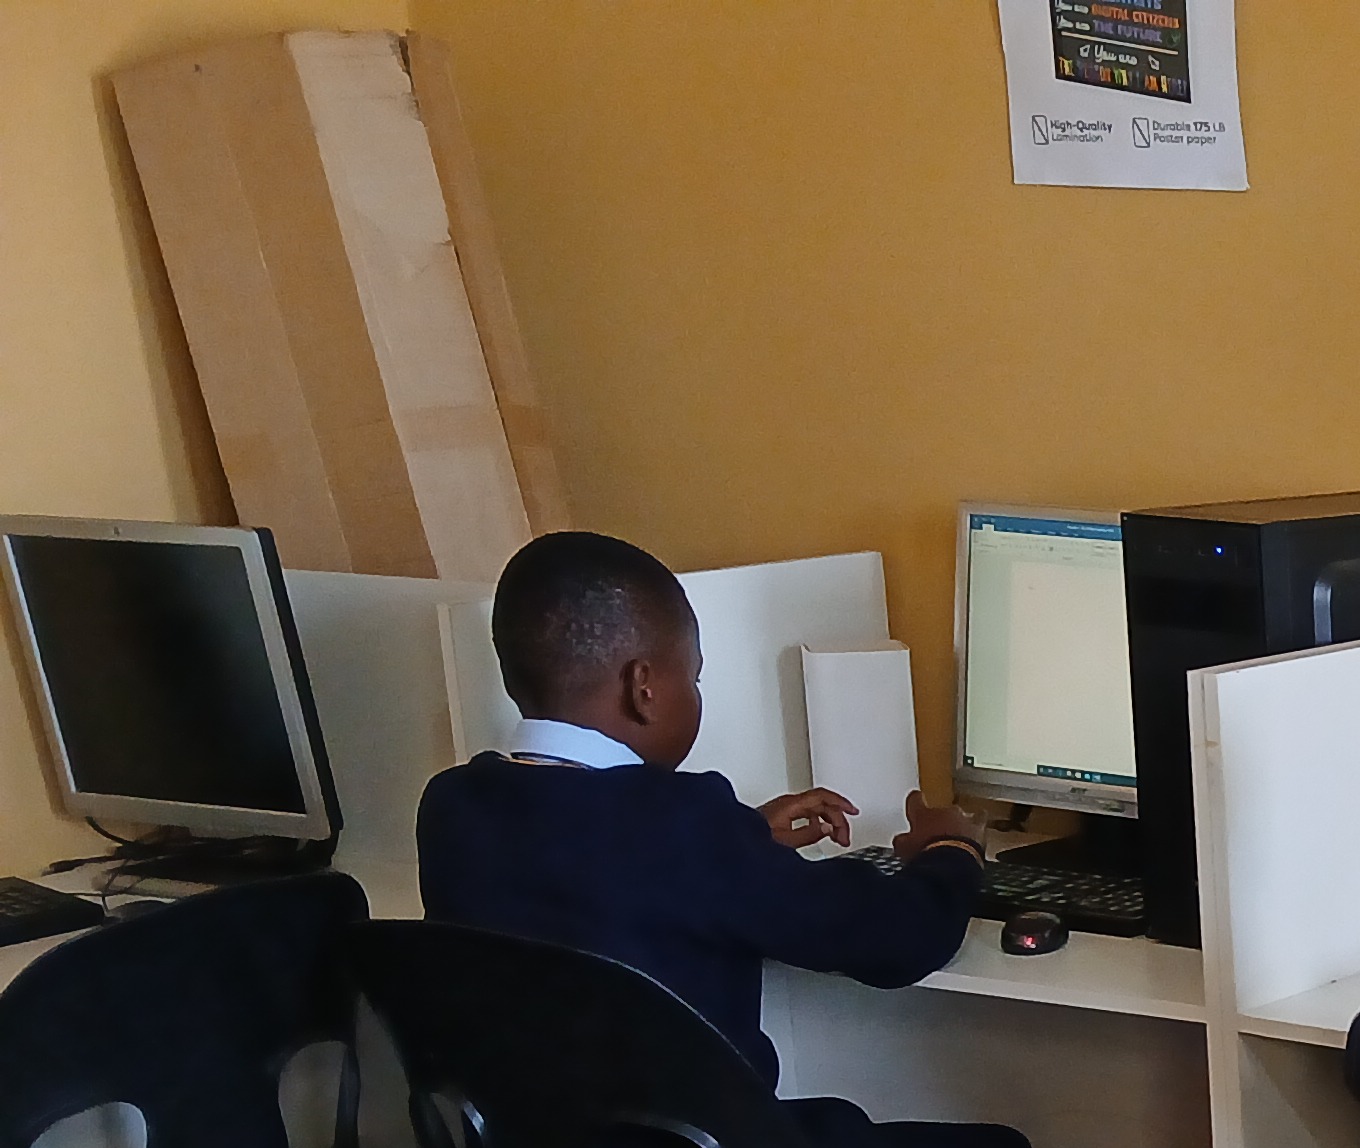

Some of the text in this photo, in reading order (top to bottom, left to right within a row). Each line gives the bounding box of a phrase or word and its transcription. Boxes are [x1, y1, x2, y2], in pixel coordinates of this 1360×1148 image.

[1091, 3, 1129, 20] DIGITAL
[1093, 20, 1114, 34] THE
[1117, 24, 1162, 43] FUTURE
[1094, 45, 1117, 63] You
[1050, 119, 1113, 134] High-Quality
[1152, 120, 1191, 133] Durable
[1192, 121, 1211, 133] 175
[1153, 133, 1217, 146] Poster paper
